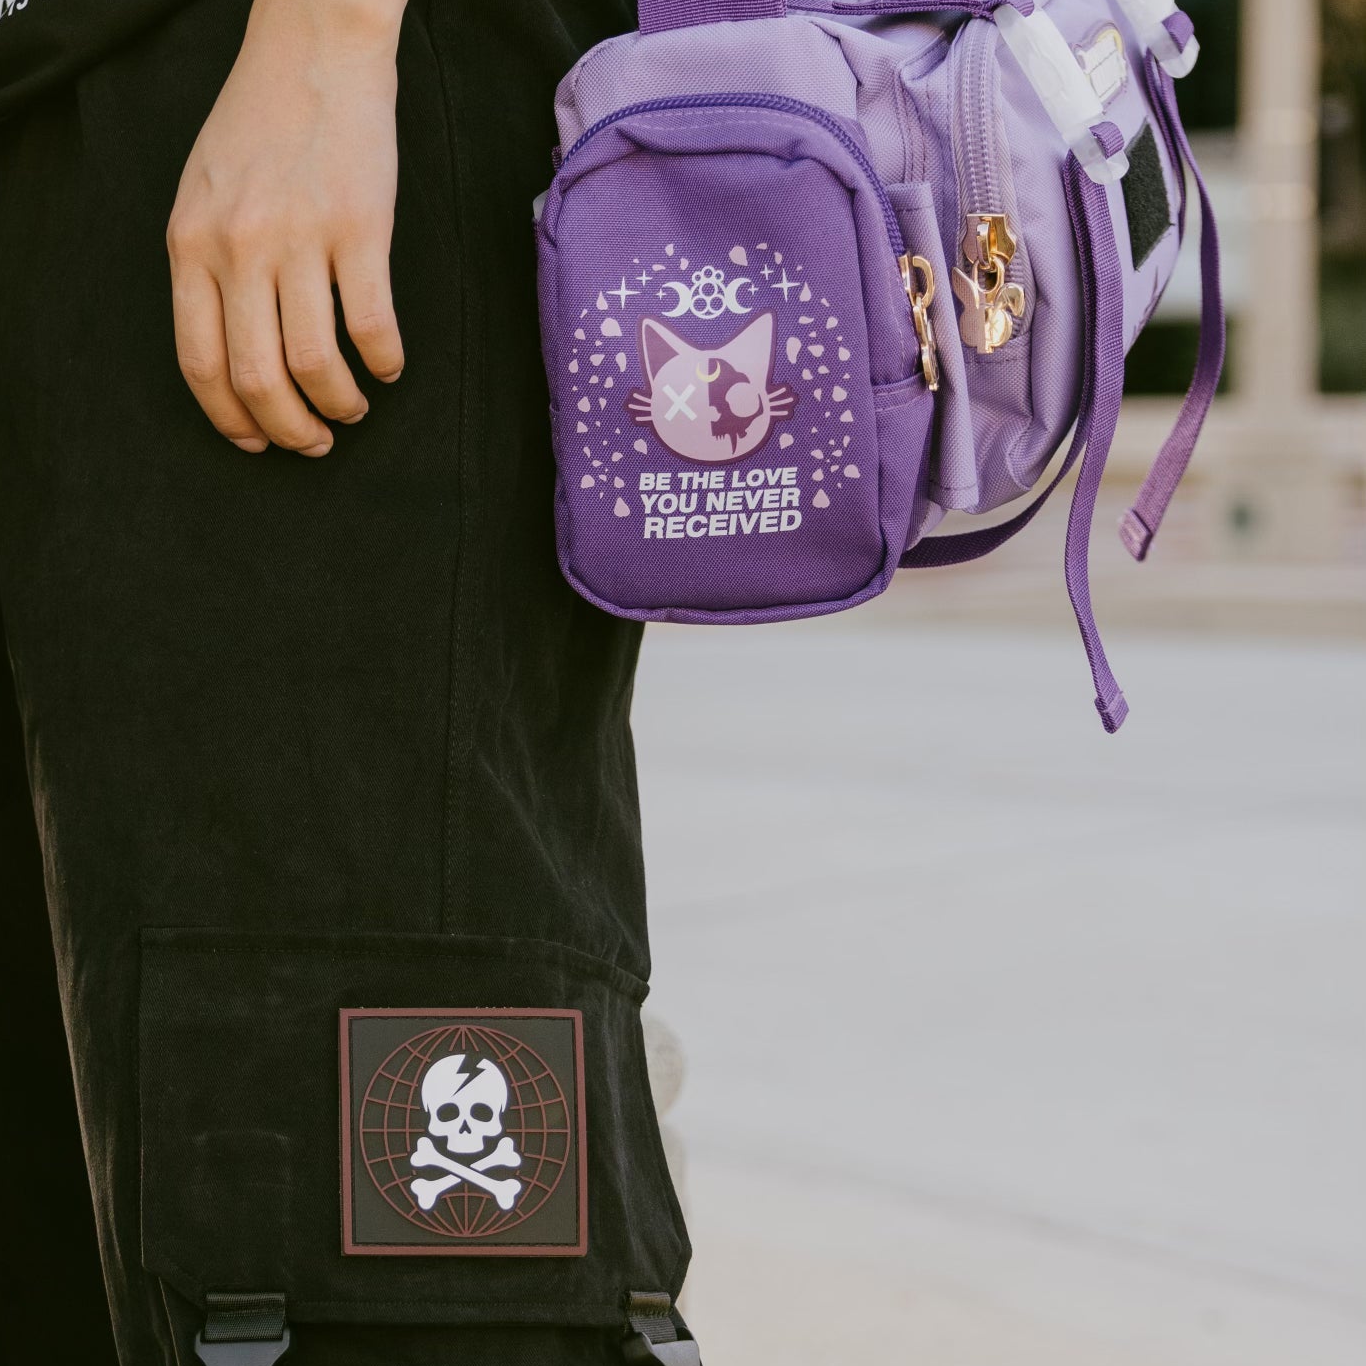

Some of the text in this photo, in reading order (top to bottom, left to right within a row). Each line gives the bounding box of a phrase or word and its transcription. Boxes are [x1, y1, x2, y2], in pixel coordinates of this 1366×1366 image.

[639, 467, 798, 491] BE THE LOVE
[640, 488, 801, 514] YOU NEVER
[643, 509, 803, 539] RECEIVED
